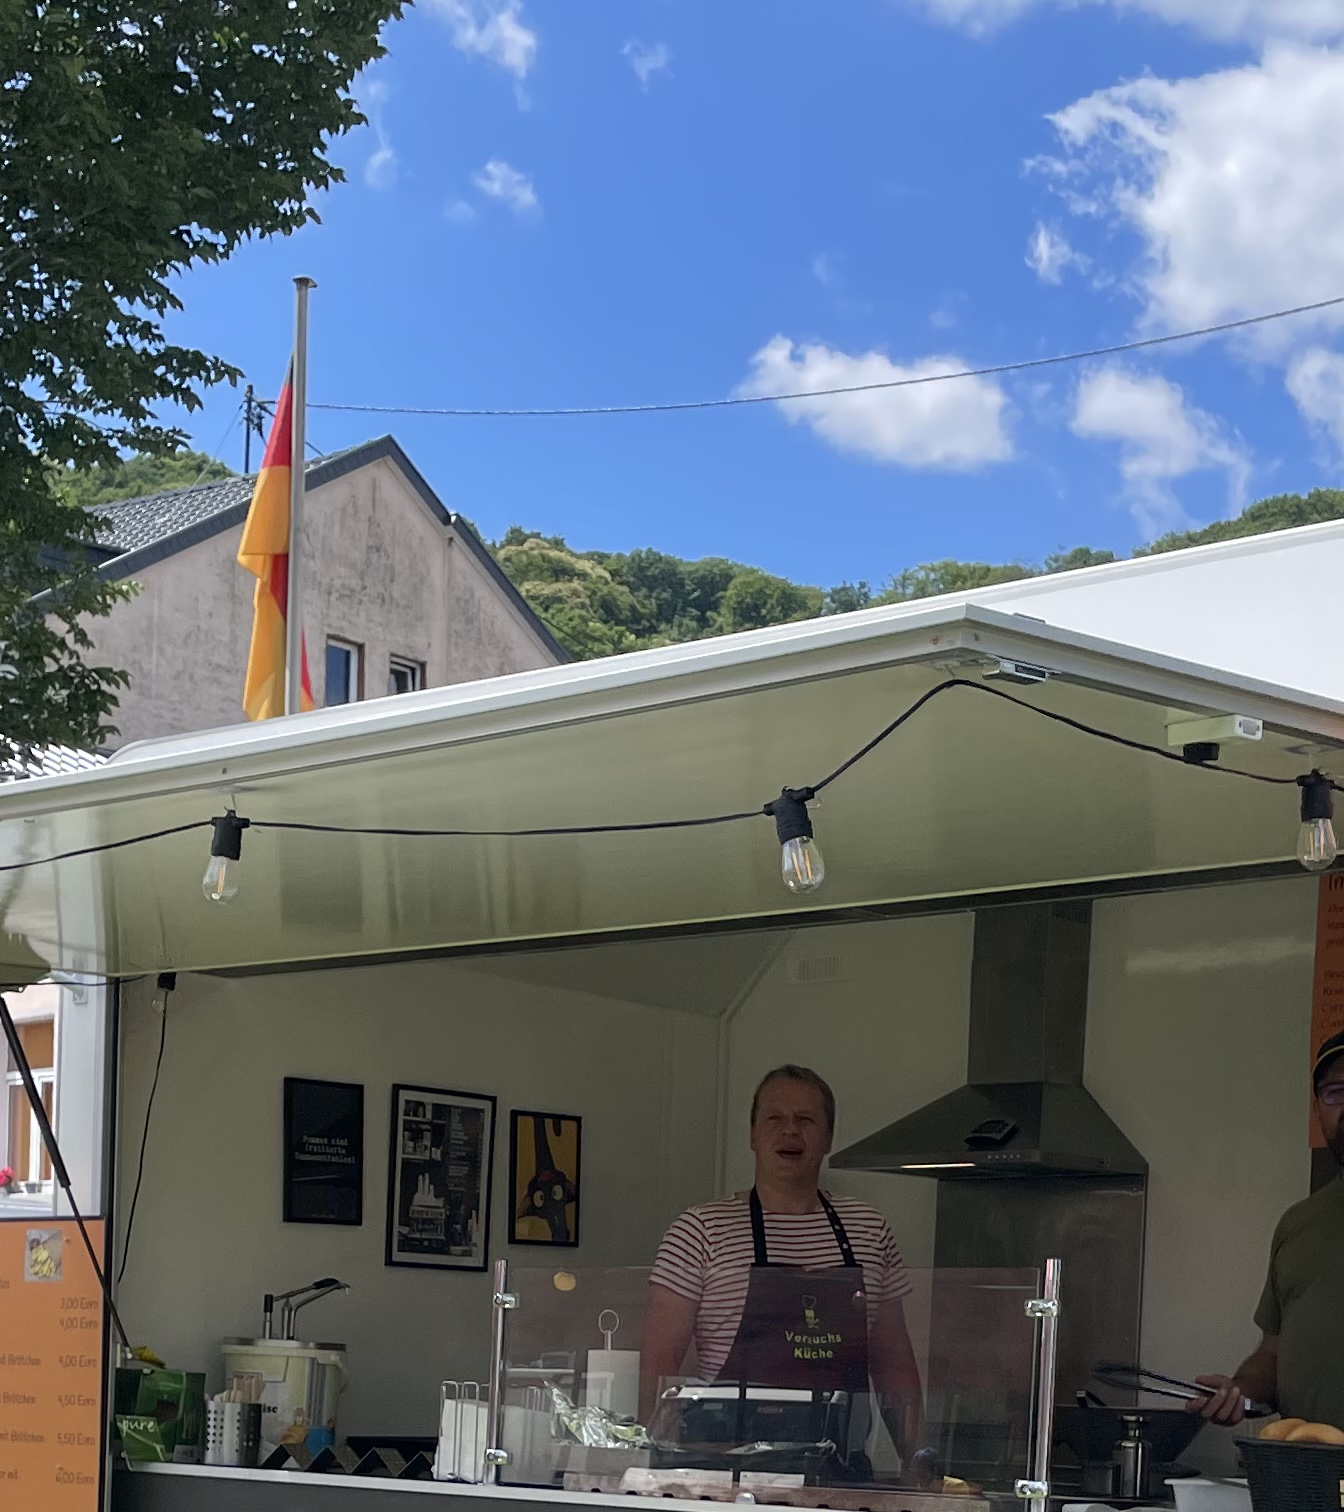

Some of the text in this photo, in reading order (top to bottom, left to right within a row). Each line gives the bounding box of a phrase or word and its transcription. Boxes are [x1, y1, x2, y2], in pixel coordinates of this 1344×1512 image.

[80, 1297, 98, 1310] Euro
[79, 1317, 98, 1329] Euro
[785, 1330, 842, 1344] Versuchs
[794, 1348, 833, 1359] Küche
[78, 1355, 98, 1368] Euro
[122, 1418, 156, 1437] pure
